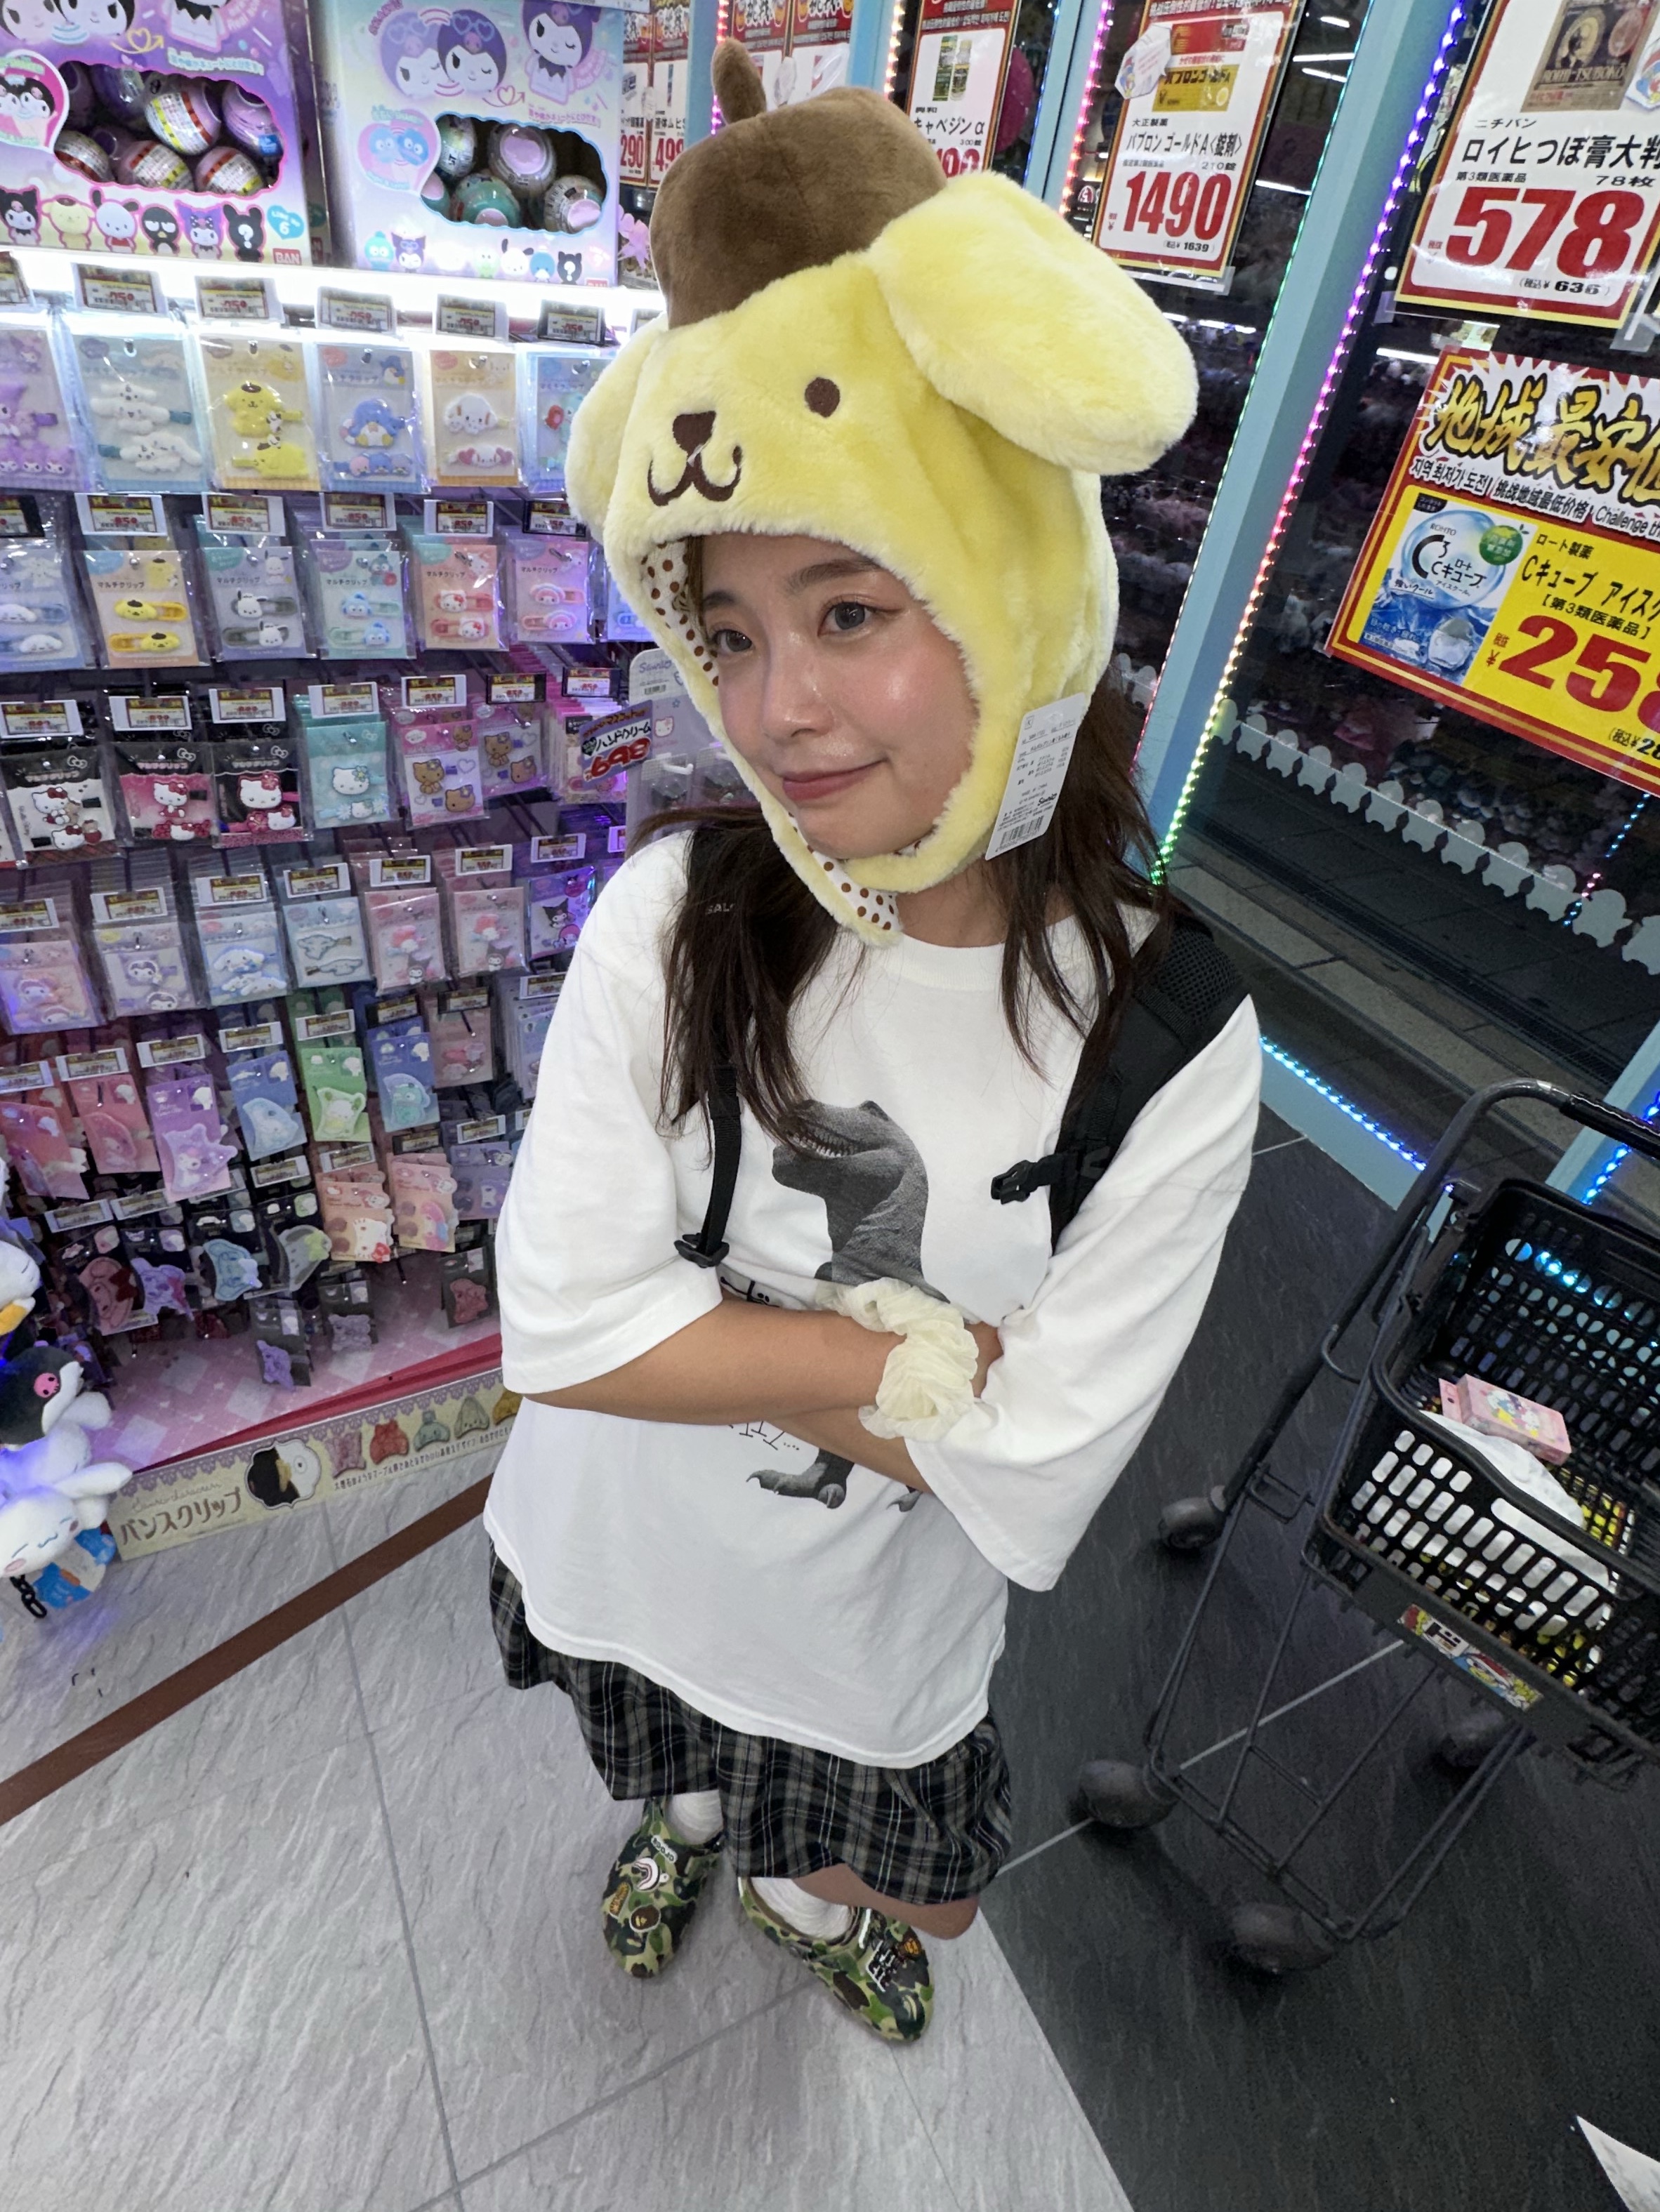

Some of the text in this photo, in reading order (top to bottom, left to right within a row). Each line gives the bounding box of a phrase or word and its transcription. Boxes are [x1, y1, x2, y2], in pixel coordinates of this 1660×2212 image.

[1132, 118, 1168, 127] 大正製薬
[1475, 119, 1537, 129] ニチバン
[620, 134, 643, 168] 290
[1126, 132, 1163, 154] パブロン
[1201, 161, 1237, 171] 210錠
[1456, 172, 1527, 183] 第3類医薬品
[1595, 175, 1656, 187] 78枚
[1124, 171, 1232, 241] 1490
[279, 221, 290, 235] 6
[1445, 186, 1645, 279] 578
[1411, 458, 1431, 476] 지역
[1432, 465, 1464, 488] 최저가
[1430, 523, 1457, 536] ROHTO
[1595, 505, 1649, 534] Challenge
[1536, 534, 1594, 559] ロート製薬
[1431, 561, 1487, 588] Cキューブ
[1455, 558, 1473, 570] ロート
[1394, 579, 1434, 595] 強いクール
[1522, 555, 1598, 597] Cキューブ
[1486, 649, 1501, 667] ¥
[596, 721, 652, 751] ハンドクリーム
[591, 737, 651, 777] 698
[120, 1485, 242, 1545] バンスクリップ
